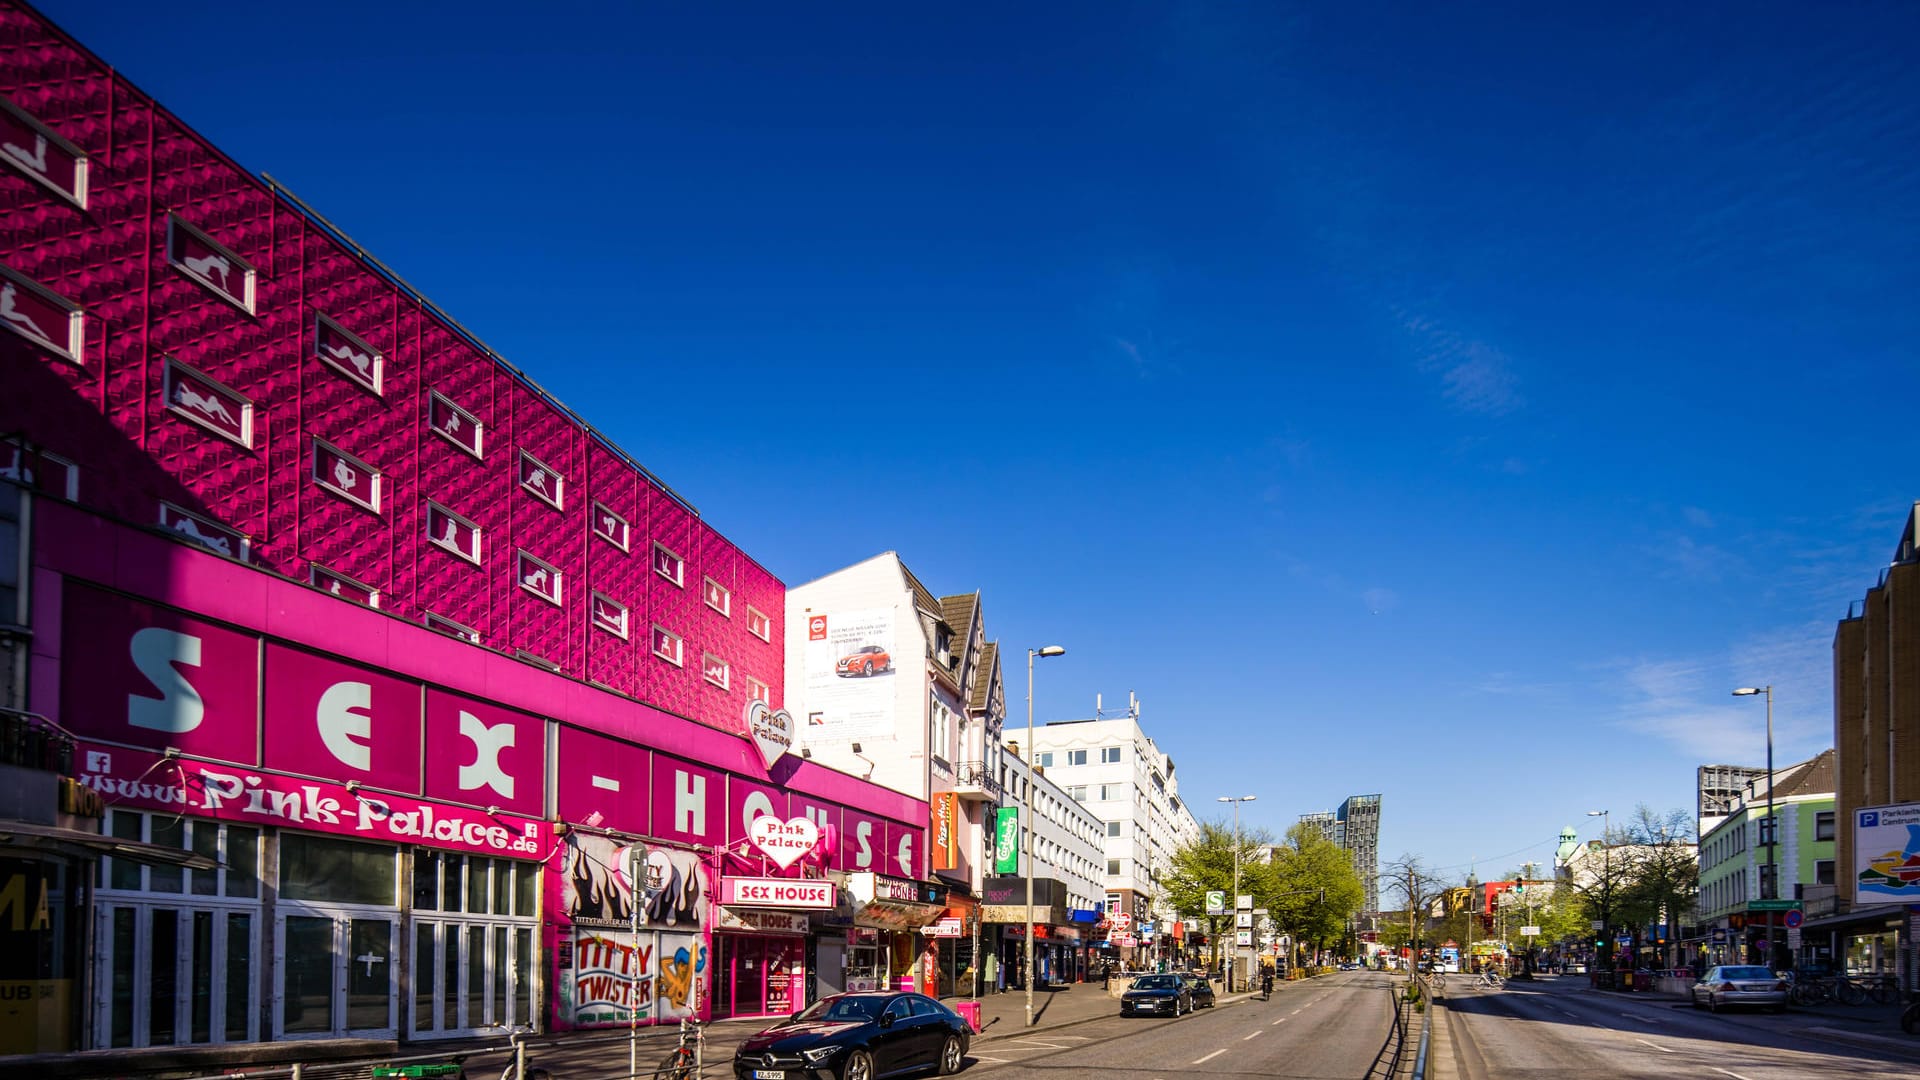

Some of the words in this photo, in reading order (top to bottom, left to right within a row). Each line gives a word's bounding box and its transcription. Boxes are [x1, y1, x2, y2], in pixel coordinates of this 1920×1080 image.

[760, 710, 787, 731] Pink
[752, 724, 793, 747] Palace
[767, 823, 804, 836] Pink
[938, 819, 948, 848] Pizza
[997, 817, 1017, 861] Carlsberg
[757, 836, 812, 849] Palace
[741, 886, 769, 899] SEX
[775, 887, 825, 900] HOUSE
[1208, 893, 1224, 908] S
[739, 912, 759, 927] SEX
[760, 913, 792, 929] HOUSE
[576, 936, 653, 975] TITTY
